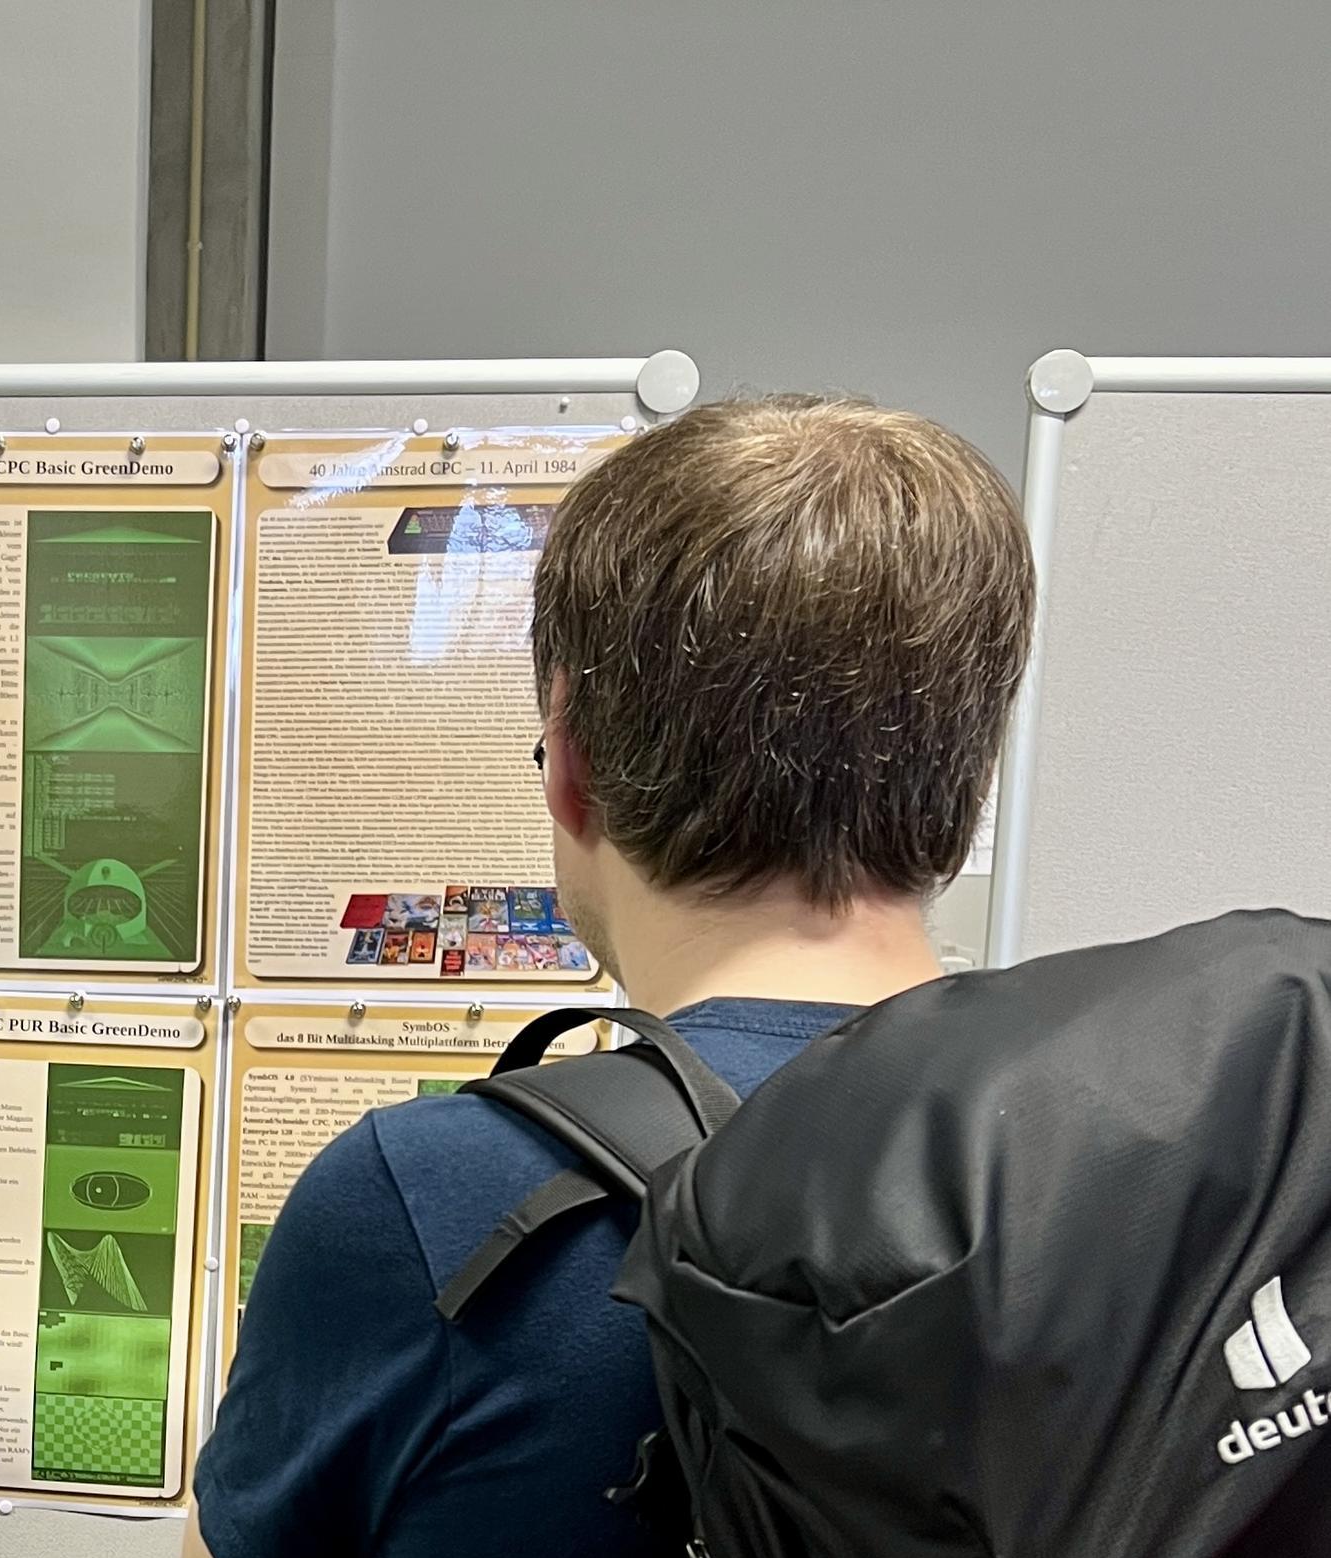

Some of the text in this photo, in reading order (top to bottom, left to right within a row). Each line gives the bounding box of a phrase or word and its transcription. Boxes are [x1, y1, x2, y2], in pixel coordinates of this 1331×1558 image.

[36, 461, 76, 475] Basic
[81, 461, 173, 476] GreenDemo
[309, 464, 325, 477] 40
[371, 462, 426, 477] Amstrad
[430, 462, 461, 475] CPC
[480, 462, 500, 474] 11.
[504, 461, 538, 476] April
[544, 461, 576, 473] 1984
[9, 1018, 42, 1033] PUR
[49, 1020, 87, 1035] Basic
[92, 1021, 180, 1039] GreenDemo
[402, 1021, 450, 1033] SymbOS
[277, 1033, 294, 1043] das
[298, 1034, 304, 1043] 8
[308, 1034, 323, 1044] Bit
[326, 1035, 394, 1047] Multitasking
[397, 1036, 479, 1049] Multiplattform
[1218, 1389, 1331, 1464] deut
